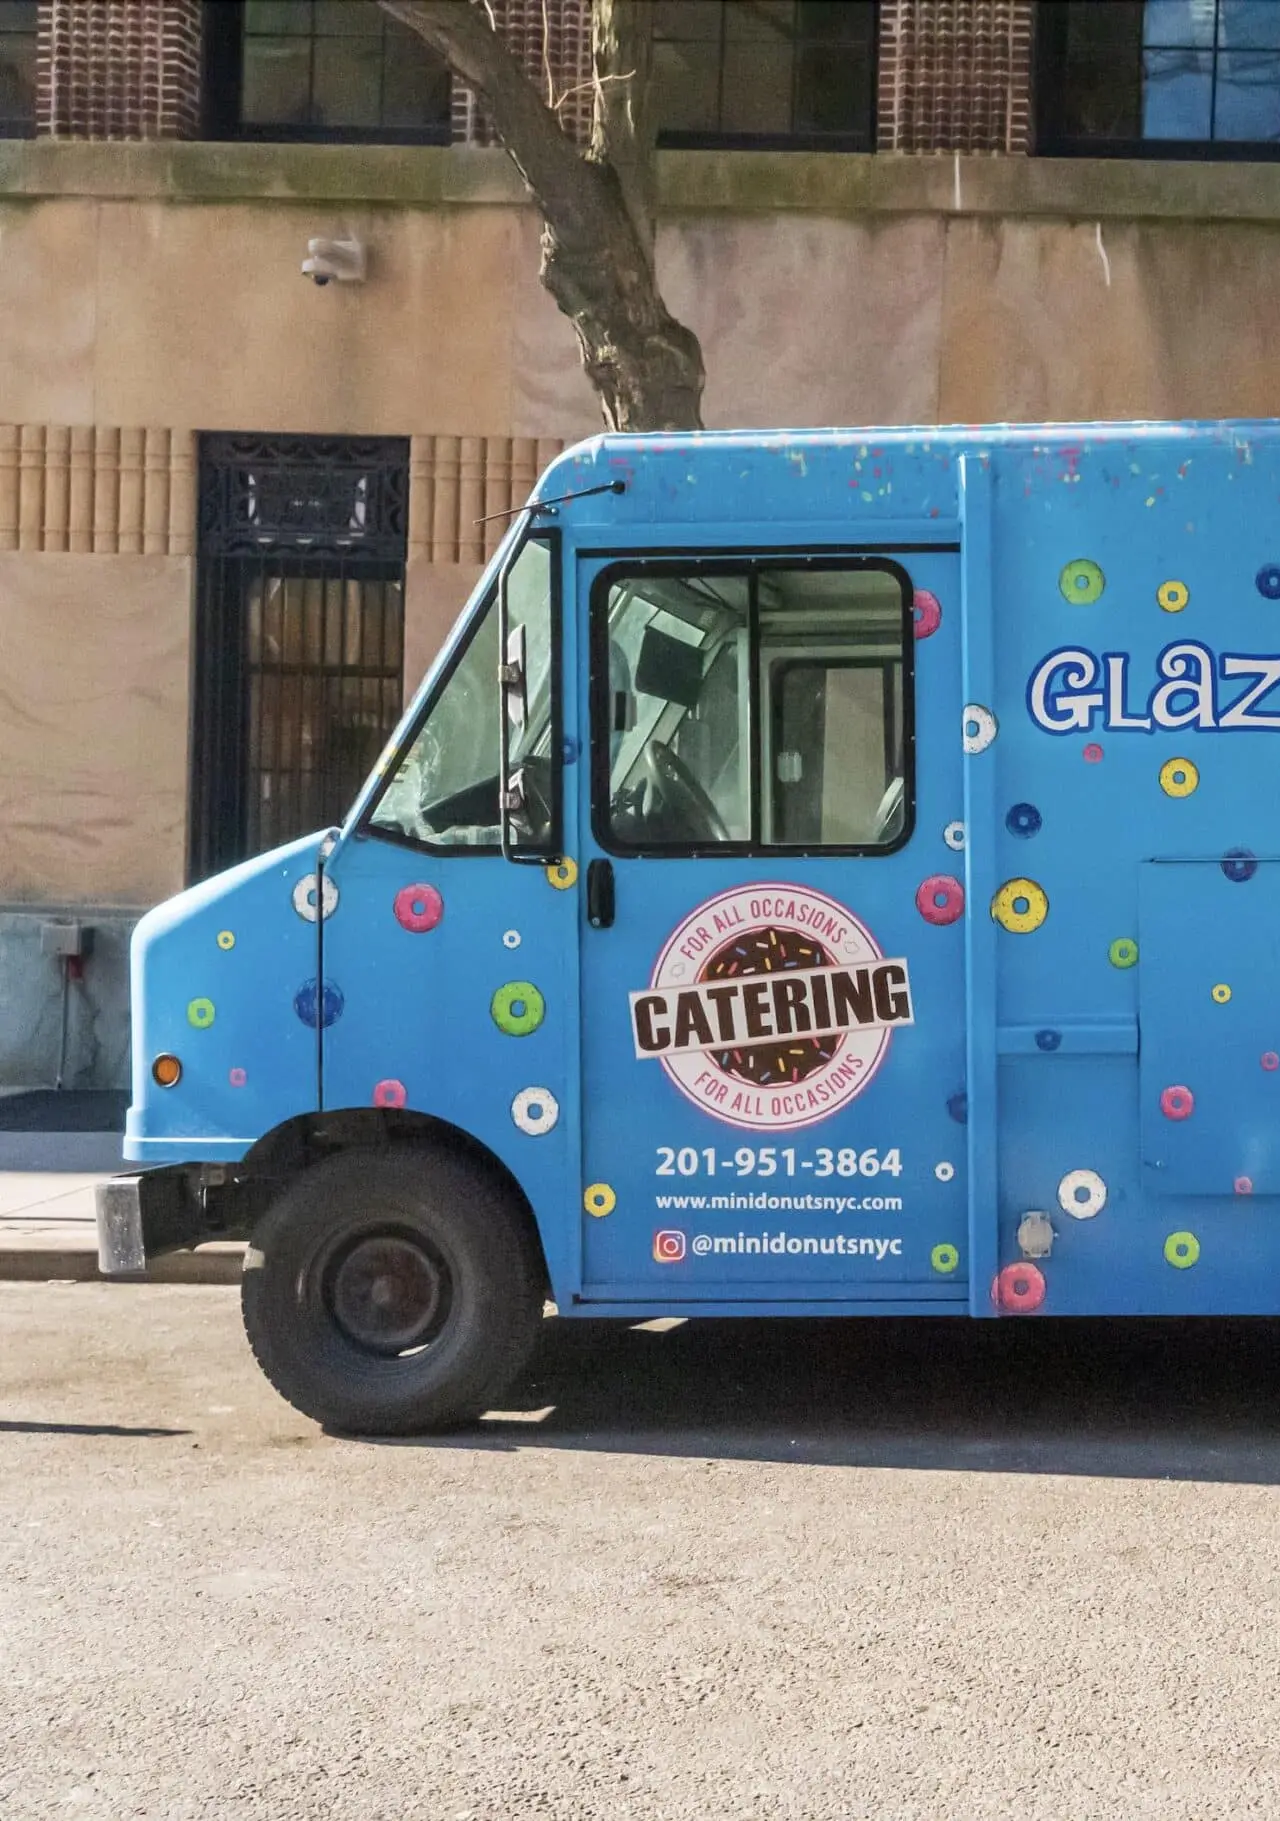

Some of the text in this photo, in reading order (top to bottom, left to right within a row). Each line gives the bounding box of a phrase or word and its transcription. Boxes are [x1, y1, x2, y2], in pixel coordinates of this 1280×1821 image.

[680, 898, 848, 960] FOR ALL OCCASIONS
[634, 965, 910, 1051] CATERING
[694, 1053, 864, 1117] FOR ALL OCCASIONS
[655, 1147, 903, 1177] 201-951-3864
[655, 1191, 903, 1215] www.minidonutsnyc.com
[691, 1231, 903, 1257] @minidonutsnyc
